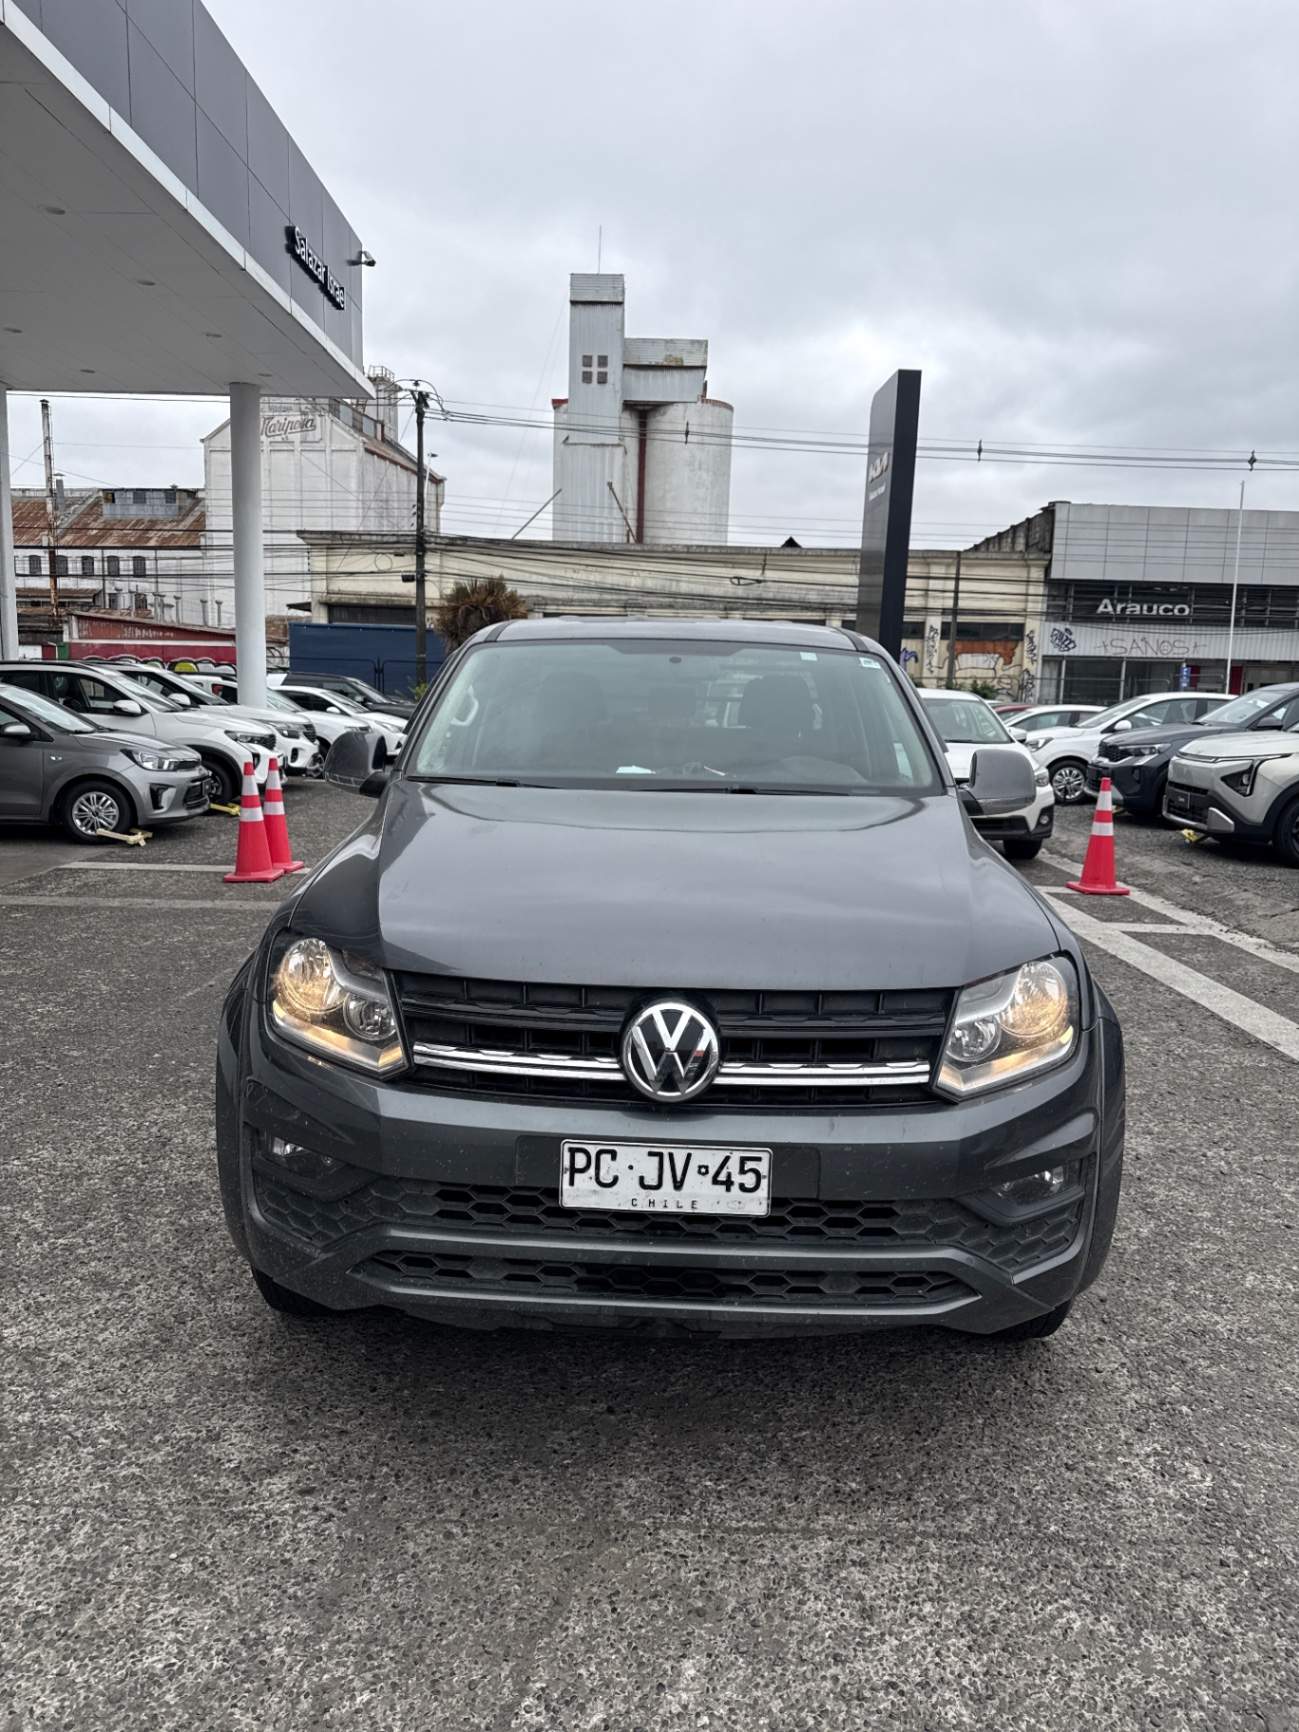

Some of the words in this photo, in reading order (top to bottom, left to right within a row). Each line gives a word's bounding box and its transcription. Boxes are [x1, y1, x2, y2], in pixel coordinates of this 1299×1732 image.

[293, 226, 326, 285] Salazar
[1096, 598, 1190, 616] Arauco
[630, 1197, 699, 1210] CHILE
